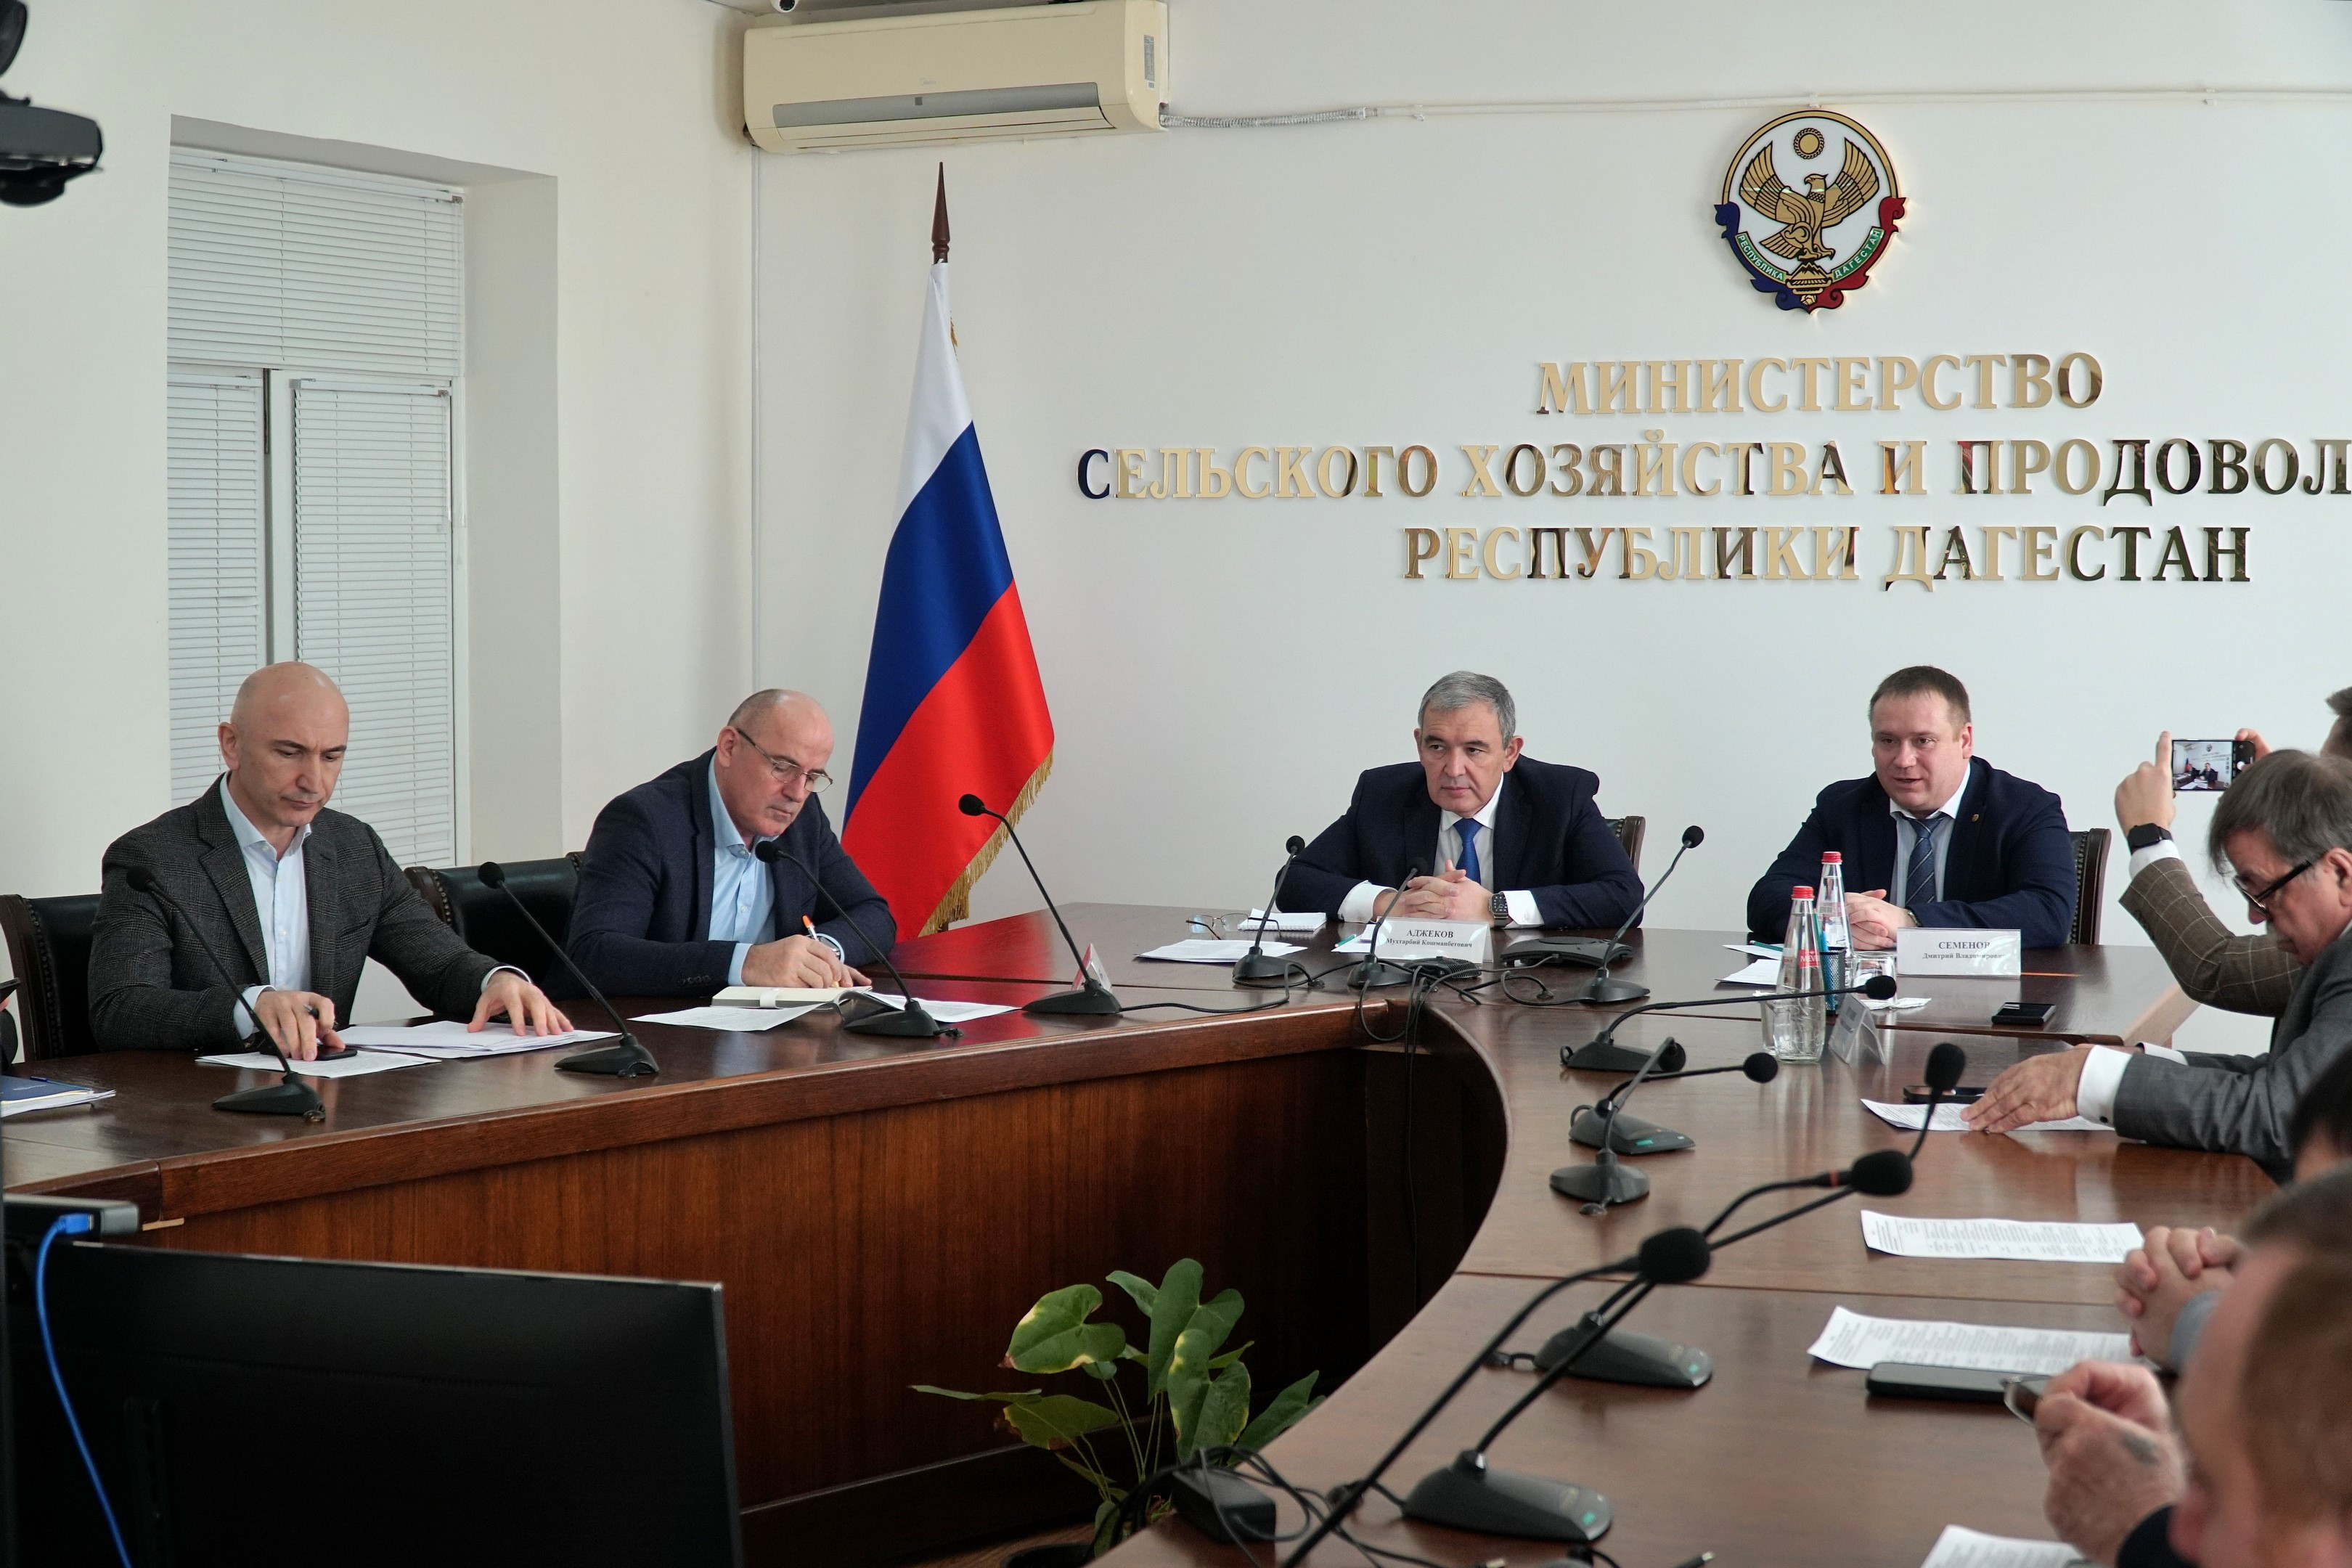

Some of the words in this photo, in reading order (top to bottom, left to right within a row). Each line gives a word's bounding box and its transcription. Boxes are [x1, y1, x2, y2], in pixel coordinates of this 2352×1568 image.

[1737, 234, 1784, 281] РЕСПУБЛИКА
[1834, 229, 1881, 279] ДАГЕСТАН
[1536, 352, 2103, 415] МИНИСТЕРСТВО
[1077, 445, 1438, 499] СЕЛЬСКОГО
[1461, 428, 1854, 497] ХОЗЯЙСТВА
[1878, 441, 1927, 495] И
[1957, 438, 2352, 507] ПРОДОВОЛ
[1402, 526, 1860, 580] РЕСПУБЛИКИ
[1884, 525, 2251, 592] ДАГЕСТАН
[1406, 929, 1454, 939] АДЖЕКОВ
